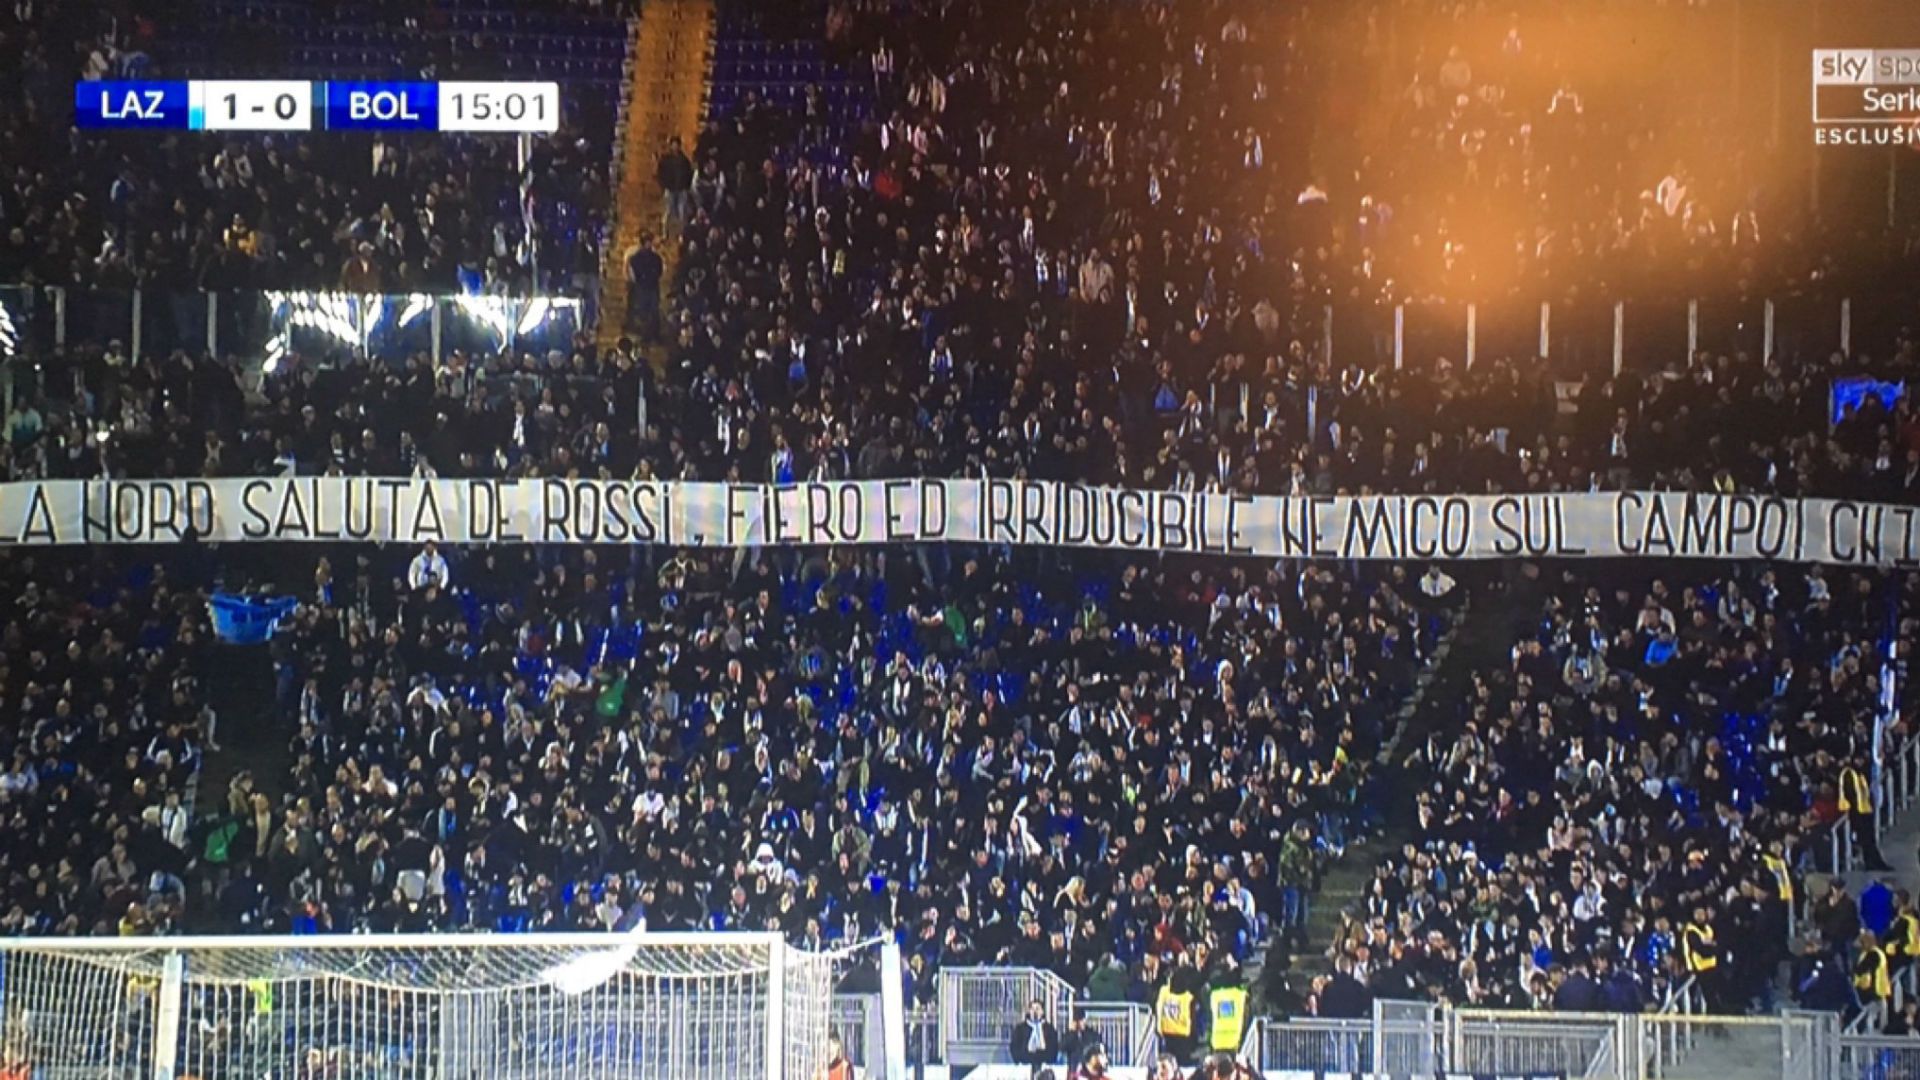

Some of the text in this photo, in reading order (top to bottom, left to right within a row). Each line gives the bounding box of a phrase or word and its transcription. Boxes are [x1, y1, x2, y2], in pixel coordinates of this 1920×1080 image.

[0, 484, 57, 542] A
[83, 481, 214, 541] NORD
[241, 480, 446, 541] SALUTA
[468, 480, 524, 541] DE
[884, 480, 948, 541] ED
[978, 479, 1254, 554] IRRIDUCIBILE
[1283, 495, 1471, 558] NEMICO
[1491, 496, 1587, 556] SUL
